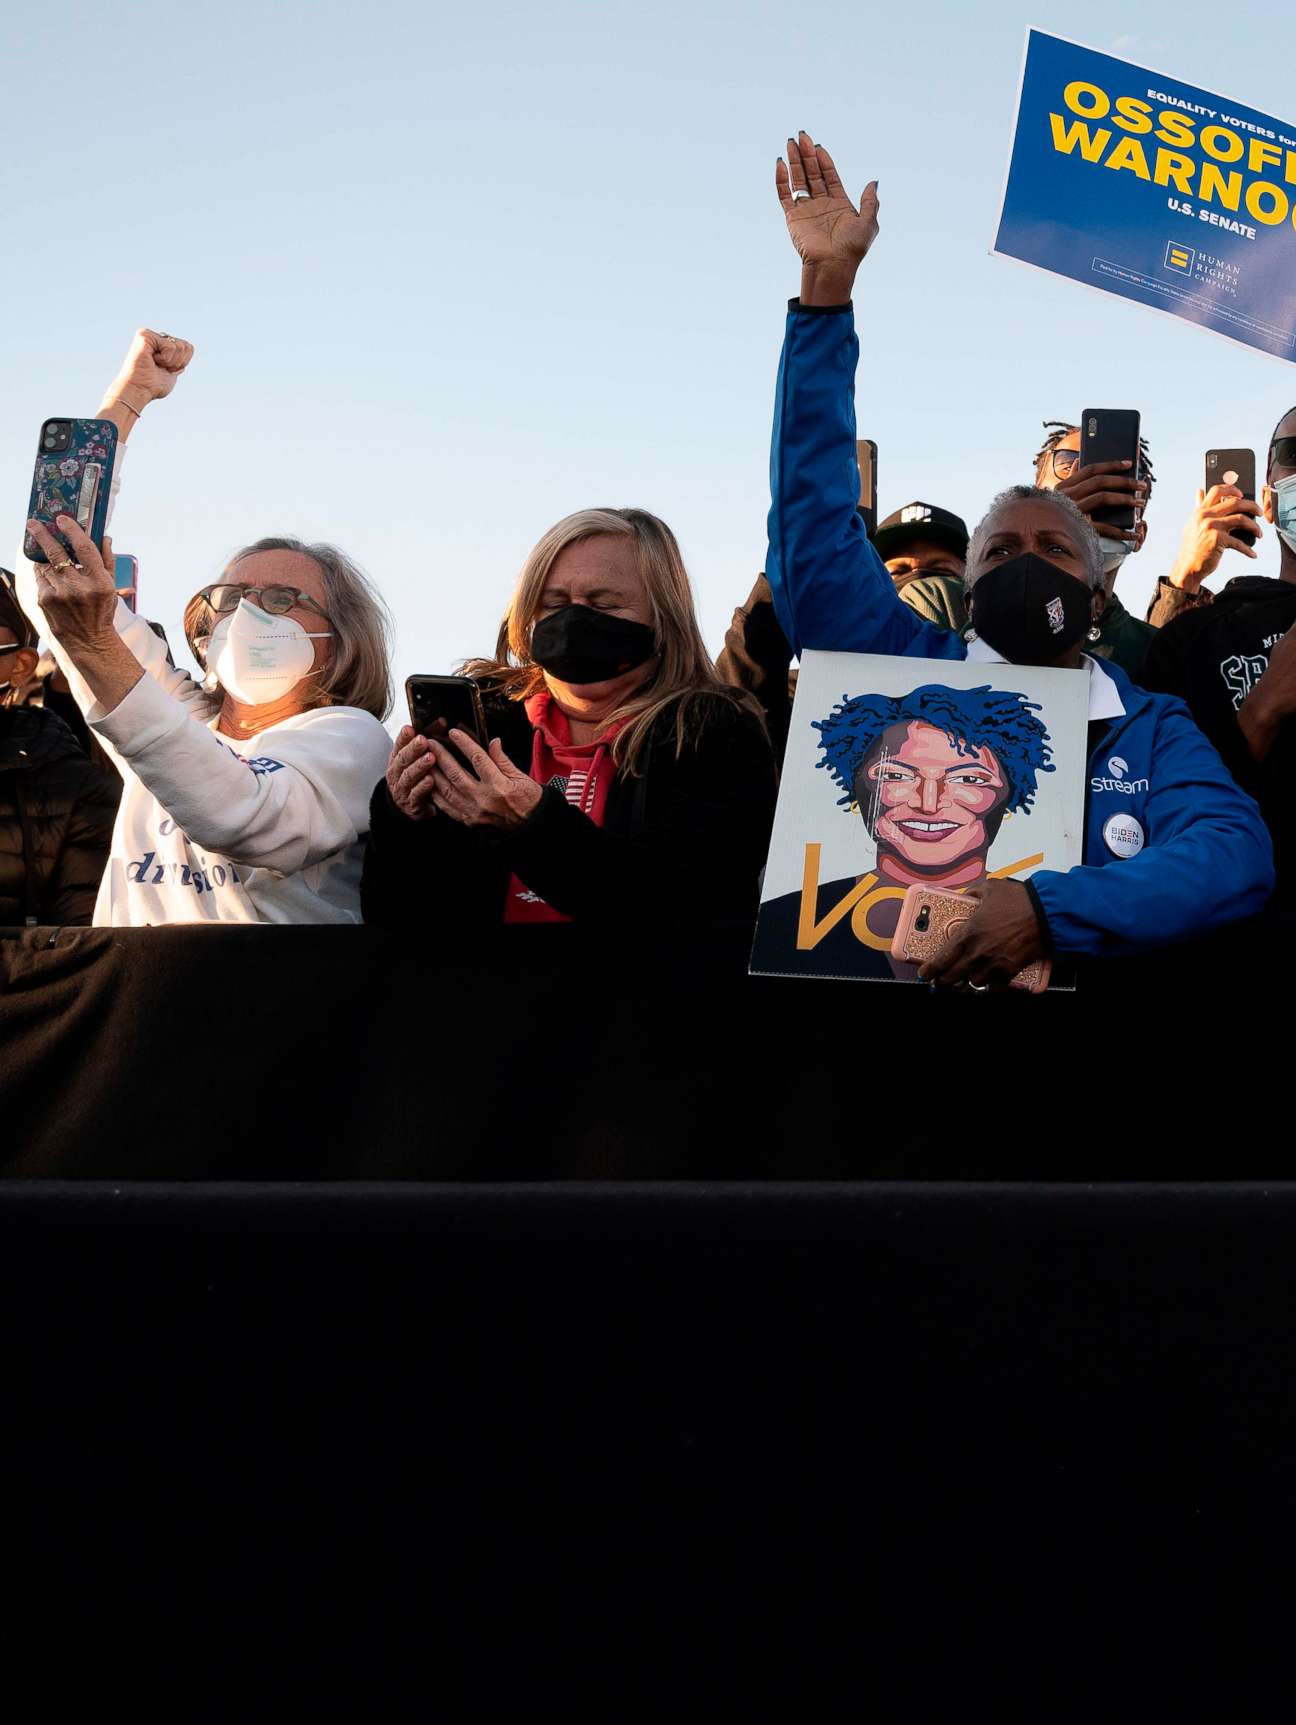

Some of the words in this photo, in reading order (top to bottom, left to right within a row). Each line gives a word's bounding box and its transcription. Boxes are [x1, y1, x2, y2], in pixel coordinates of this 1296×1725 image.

[1147, 89, 1217, 118] EQUALITY
[1221, 113, 1275, 139] VOTERS
[1279, 134, 1296, 147] for
[1167, 197, 1195, 217] U.S.
[1199, 209, 1256, 240] SENATE
[1196, 262, 1238, 285] RIGHTS
[1199, 252, 1240, 275] HUMAN
[1091, 777, 1149, 795] Stream
[1111, 827, 1139, 838] BIDEN
[1111, 835, 1139, 846] HARRIS
